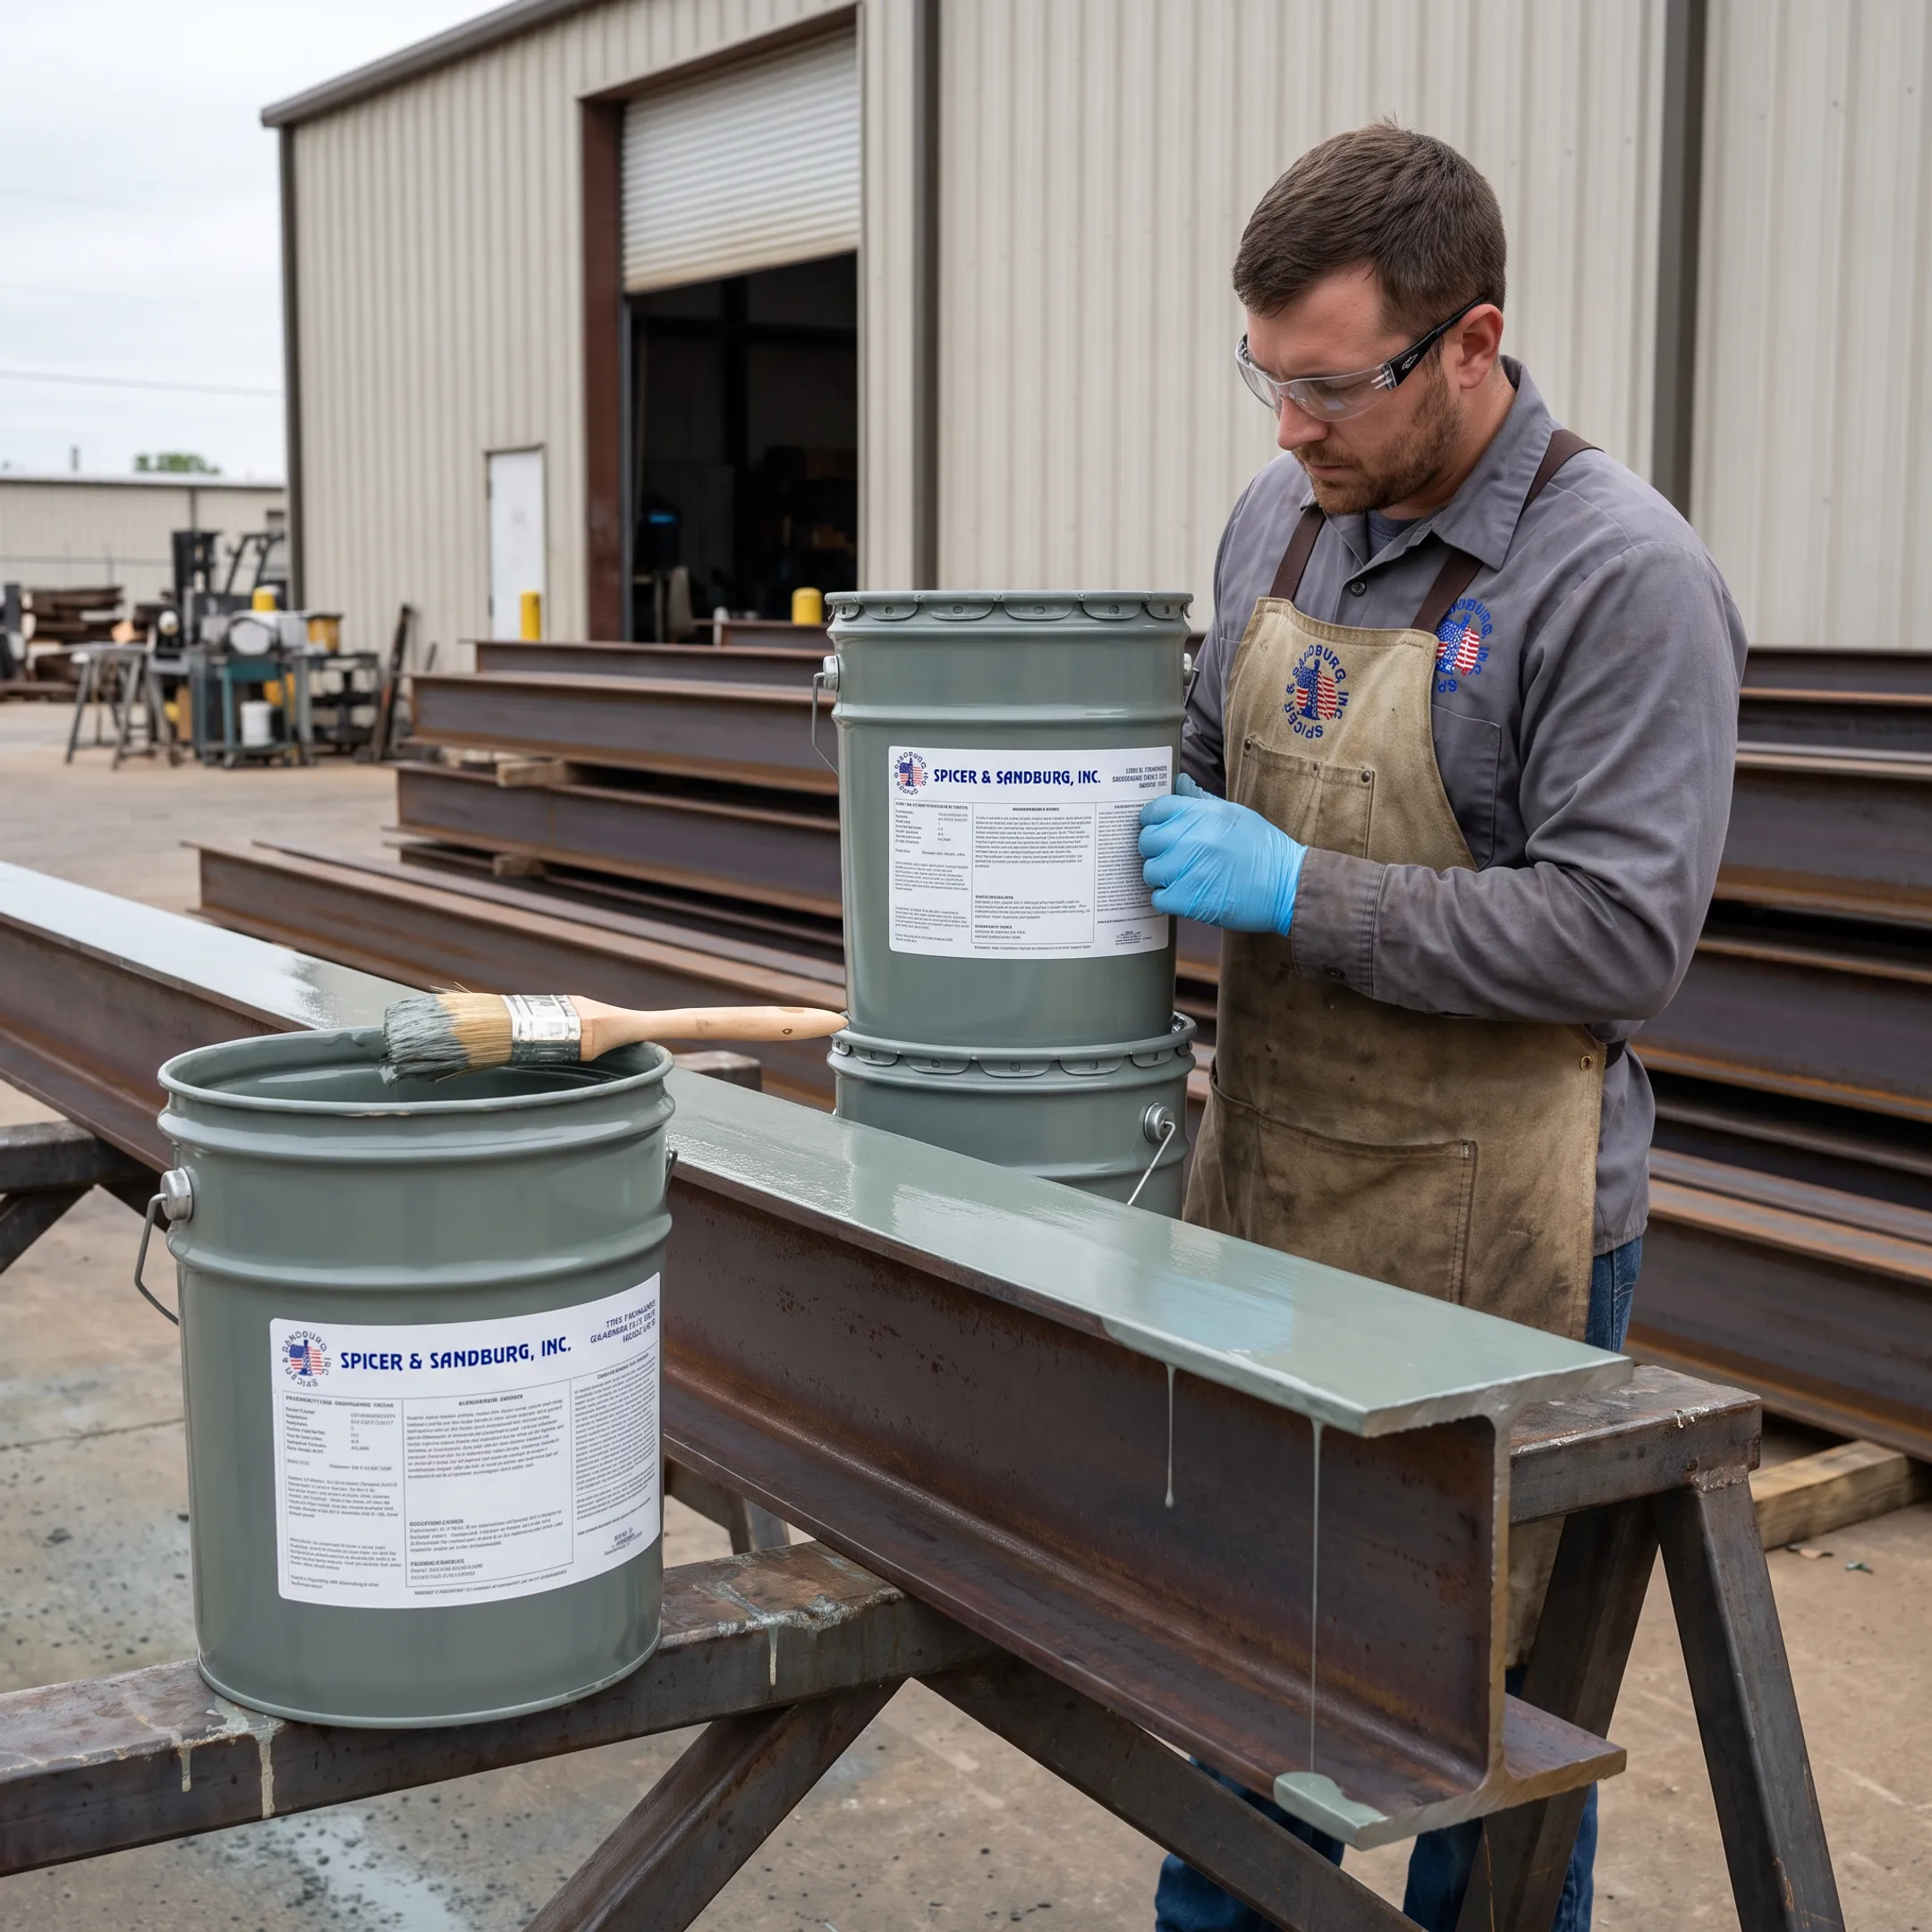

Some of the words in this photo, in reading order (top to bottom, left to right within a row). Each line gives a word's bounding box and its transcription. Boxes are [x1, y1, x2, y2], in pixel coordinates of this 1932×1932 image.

[1284, 700, 1324, 739] SPICER
[933, 768, 978, 784] SPICER
[980, 770, 992, 784] &
[996, 770, 1074, 786] SANDBURG,
[1078, 769, 1101, 784] INC.
[340, 1352, 403, 1372] SPICER
[409, 1352, 423, 1369] &
[429, 1343, 535, 1369] SANDBURG,
[541, 1336, 572, 1357] INC.
